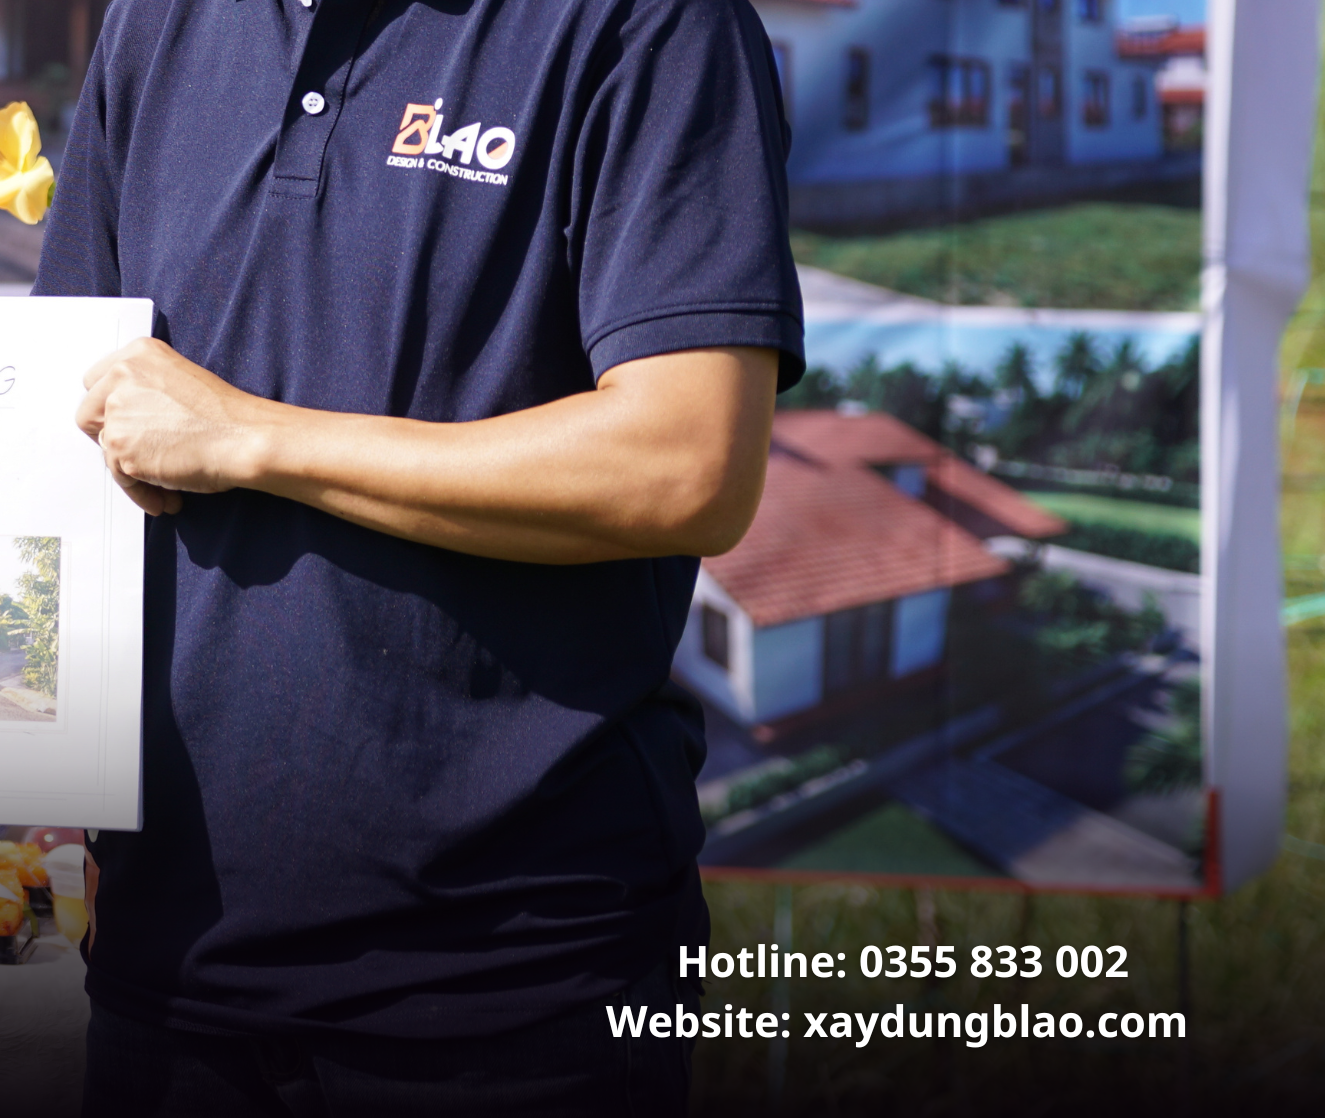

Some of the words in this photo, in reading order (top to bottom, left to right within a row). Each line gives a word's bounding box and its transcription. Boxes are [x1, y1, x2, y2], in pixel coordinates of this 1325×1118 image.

[386, 155, 418, 169] DESIGN
[418, 157, 425, 169] &
[427, 158, 509, 186] CONSTRUCTION
